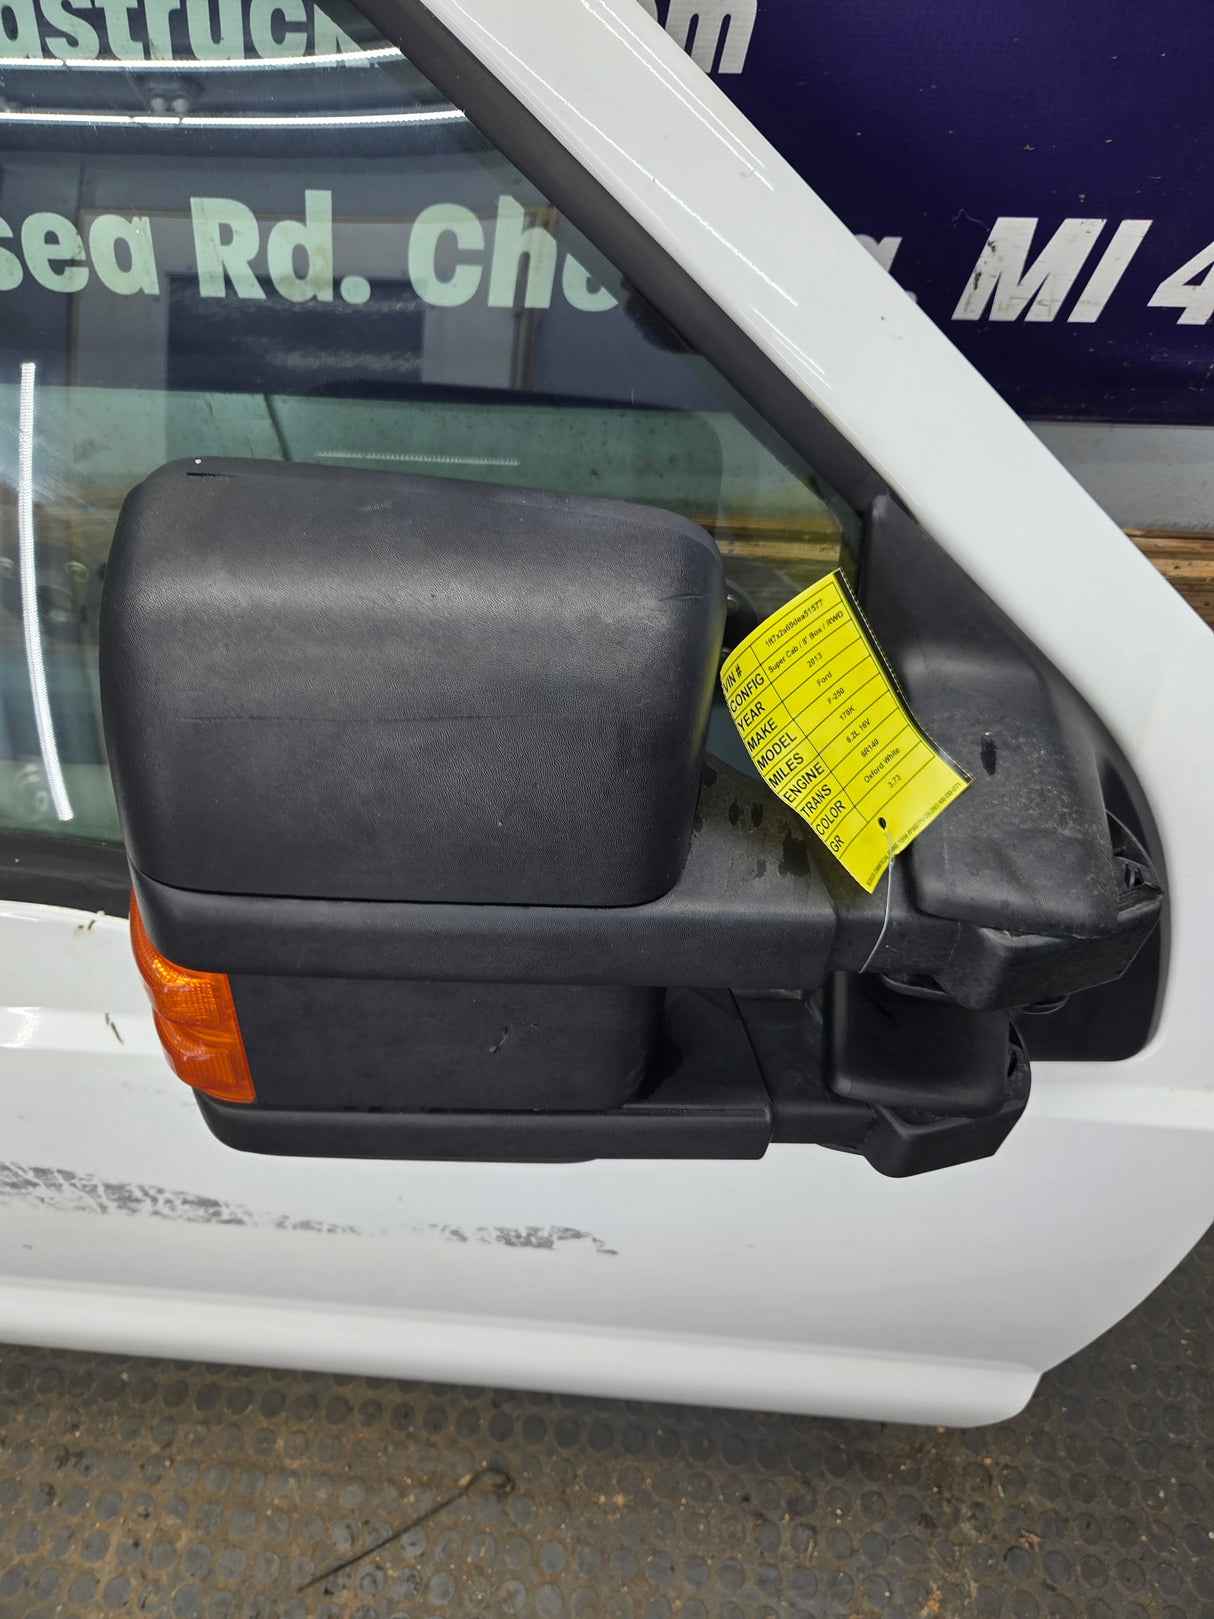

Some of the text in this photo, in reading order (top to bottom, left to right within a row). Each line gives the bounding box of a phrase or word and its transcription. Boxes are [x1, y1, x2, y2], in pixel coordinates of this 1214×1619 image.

[190, 189, 371, 304] Rd.
[951, 216, 1154, 323] MI
[722, 674, 737, 693] VIN
[730, 673, 765, 713] CONFIG
[768, 656, 786, 674] Super
[785, 645, 799, 658] Cab
[808, 626, 823, 640] Box
[826, 610, 844, 627] RWD
[737, 652, 823, 732] YEAR 2013
[746, 671, 833, 753] MAKE Ford
[756, 687, 845, 771] MODEL F-250
[768, 752, 804, 788] MILES
[783, 761, 825, 803] ENGINE
[800, 784, 832, 818] TRANS
[815, 748, 900, 835] COLOR Oxford White
[829, 774, 901, 853] GR 3.73
